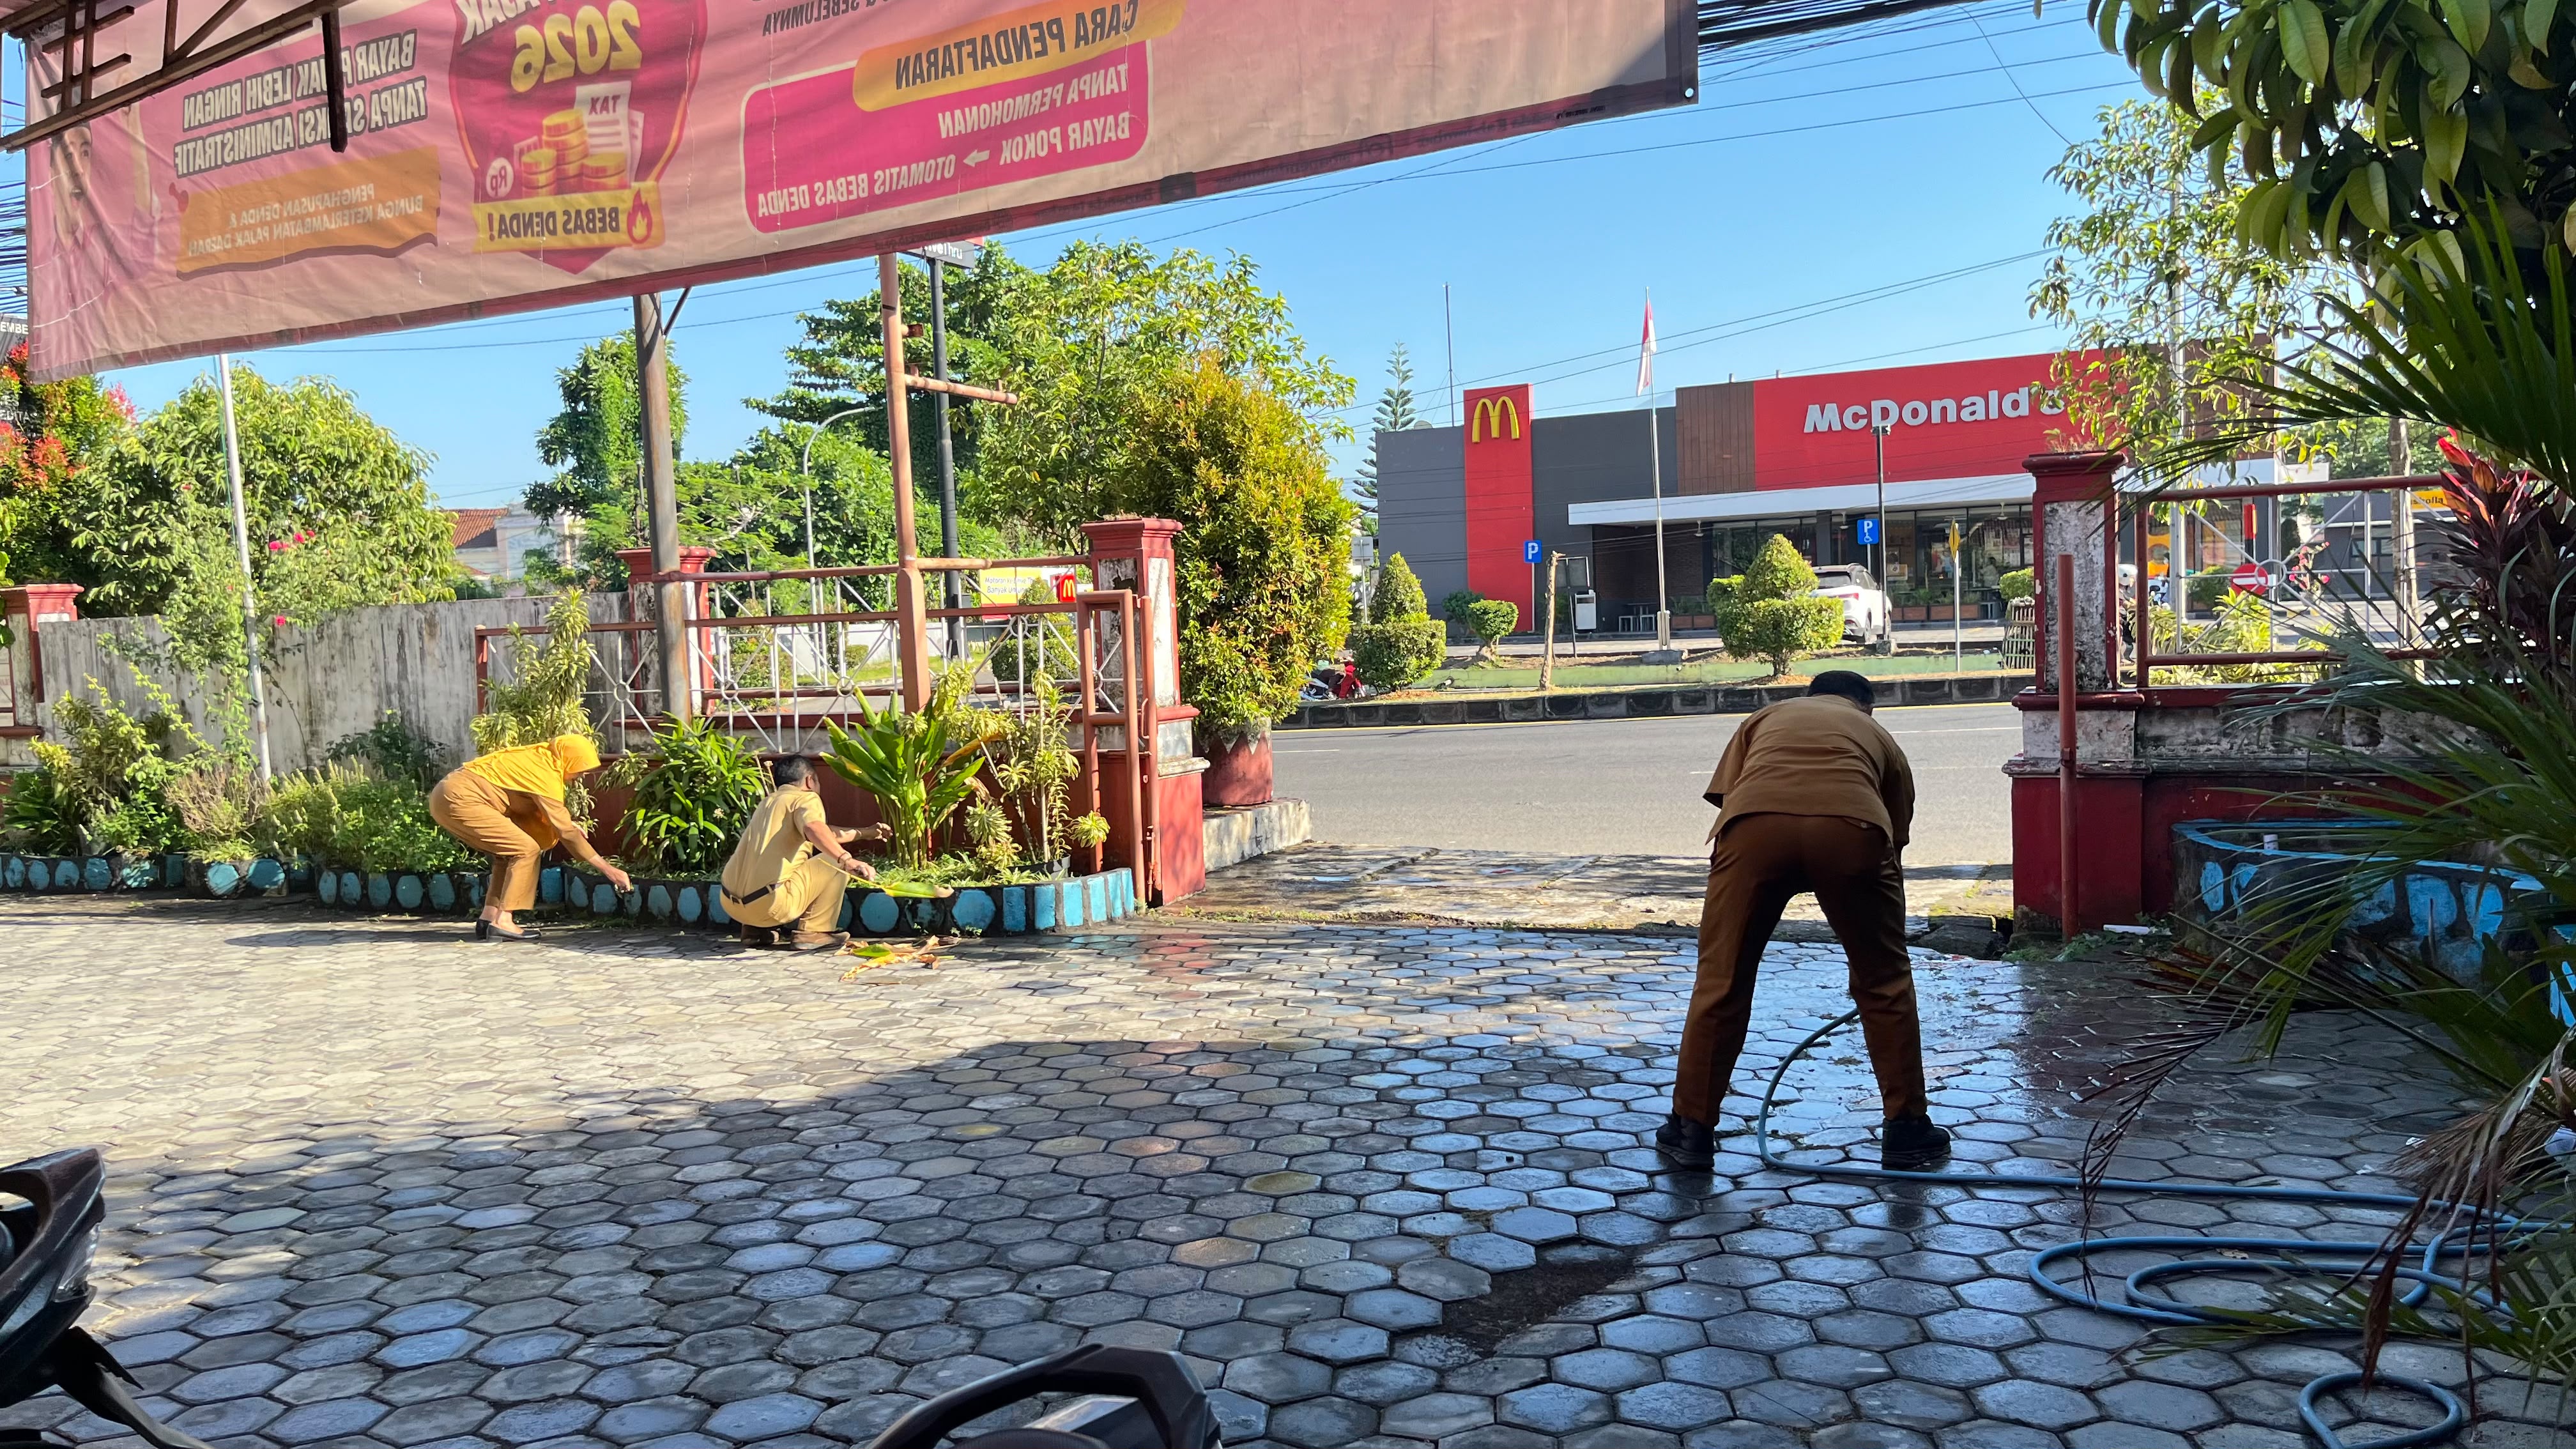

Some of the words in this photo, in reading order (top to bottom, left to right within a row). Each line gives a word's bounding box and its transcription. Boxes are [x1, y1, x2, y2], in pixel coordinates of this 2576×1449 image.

[0, 321, 29, 335] EMBE
[1804, 387, 2066, 434] McDonalds
[1864, 520, 1873, 532] P
[1528, 542, 1538, 560] P
